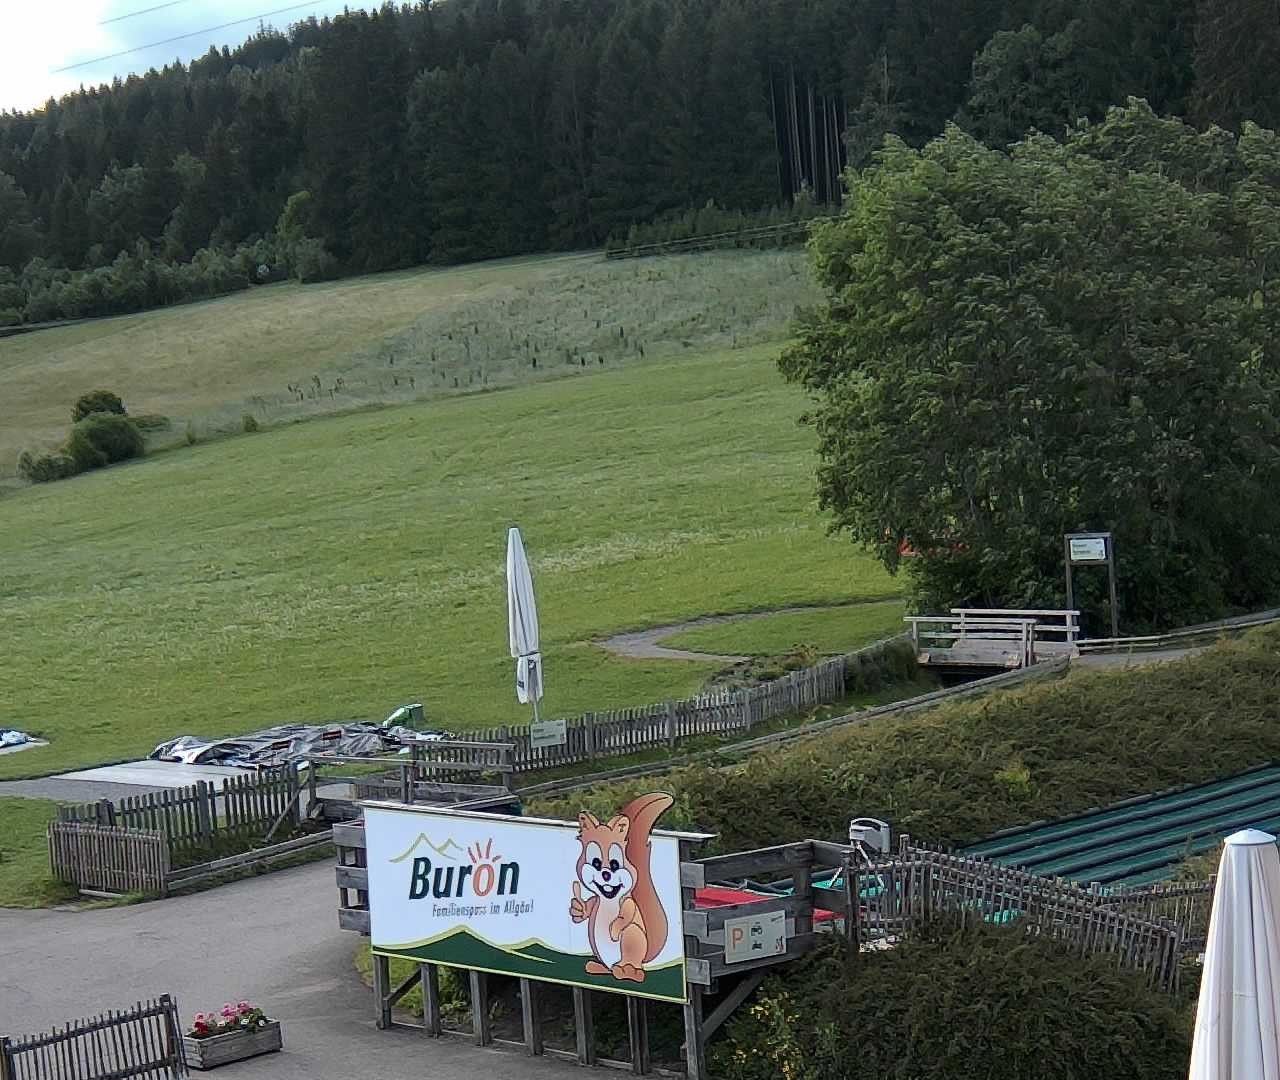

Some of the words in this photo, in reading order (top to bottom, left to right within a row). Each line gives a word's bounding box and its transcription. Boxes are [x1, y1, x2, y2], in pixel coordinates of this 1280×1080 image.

[409, 857, 520, 900] Buron
[490, 902, 500, 914] im
[732, 927, 744, 950] P
